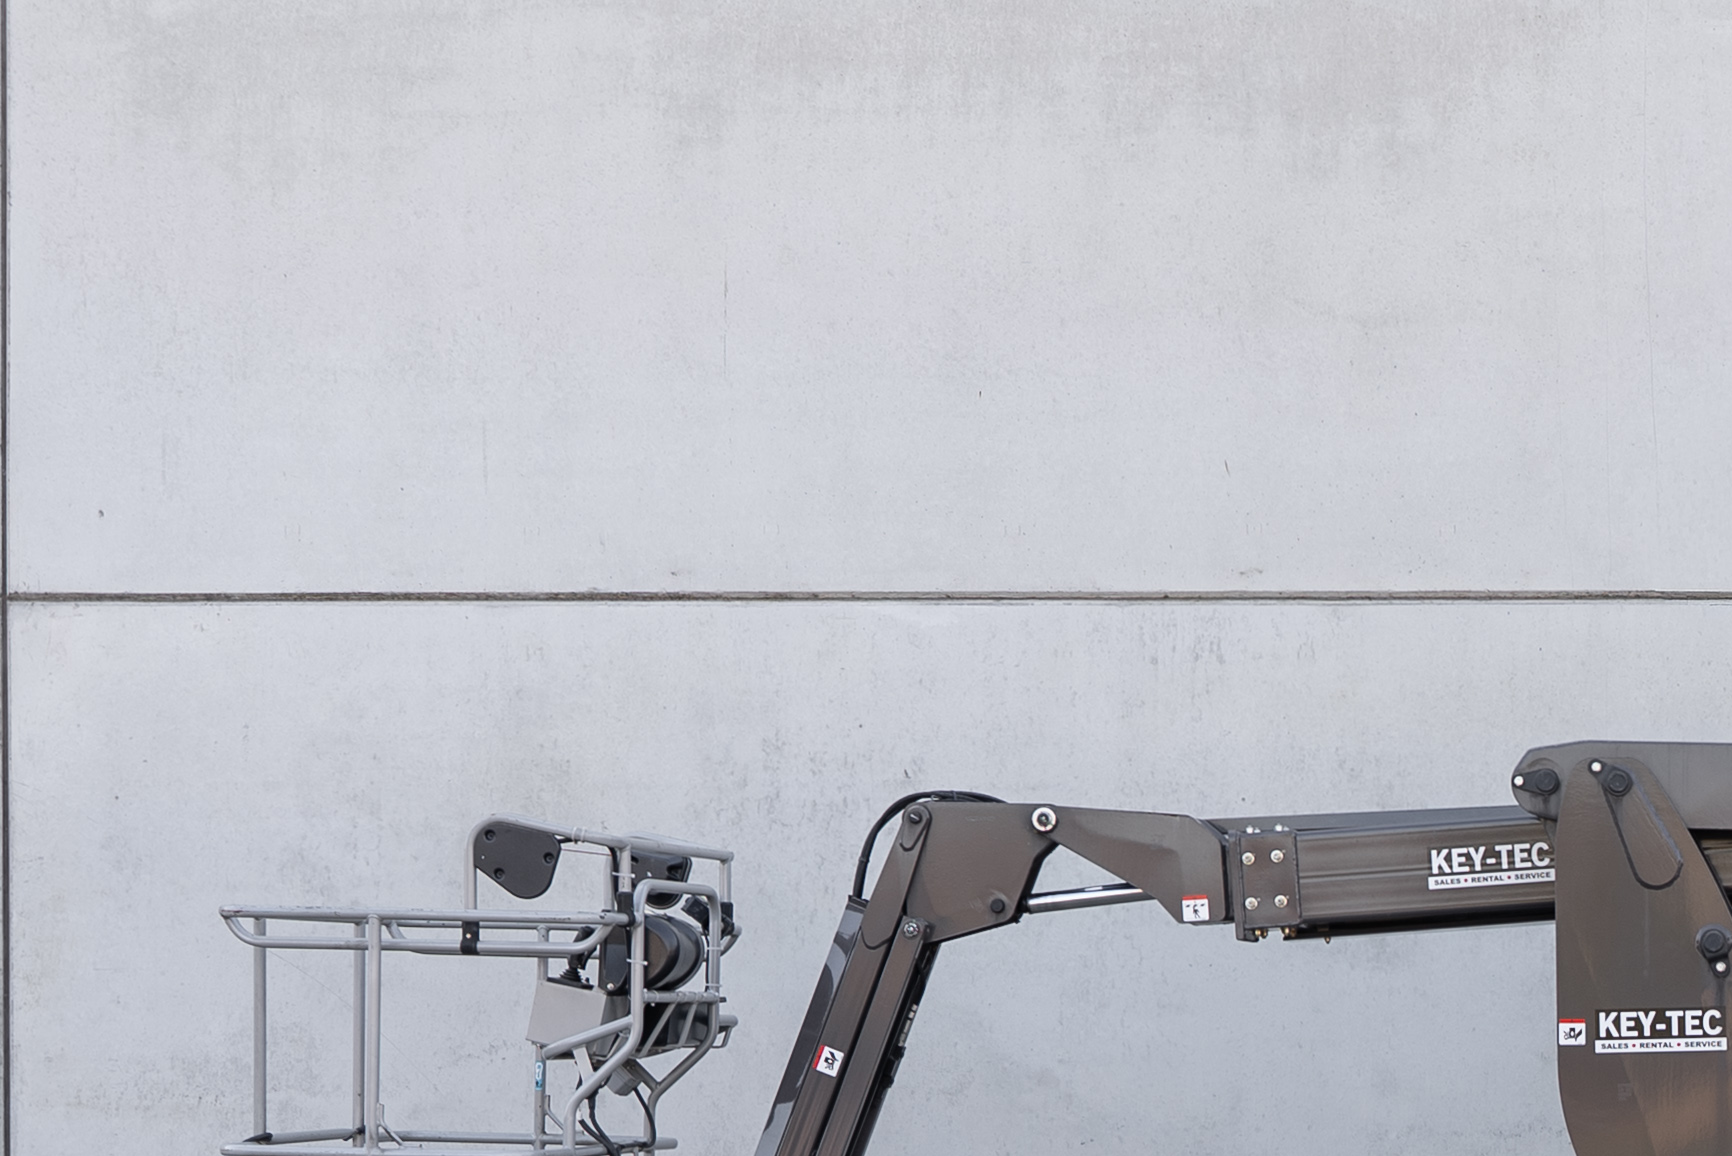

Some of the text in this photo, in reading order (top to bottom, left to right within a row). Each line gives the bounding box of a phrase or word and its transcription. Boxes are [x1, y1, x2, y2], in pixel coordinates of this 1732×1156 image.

[1430, 841, 1551, 875] KEY-TEC
[1434, 871, 1551, 886] SALES RENTAL SERVICE
[1598, 1009, 1723, 1038] KEY-TEC
[1601, 1040, 1722, 1050] SALES RENTAL SERVICE
